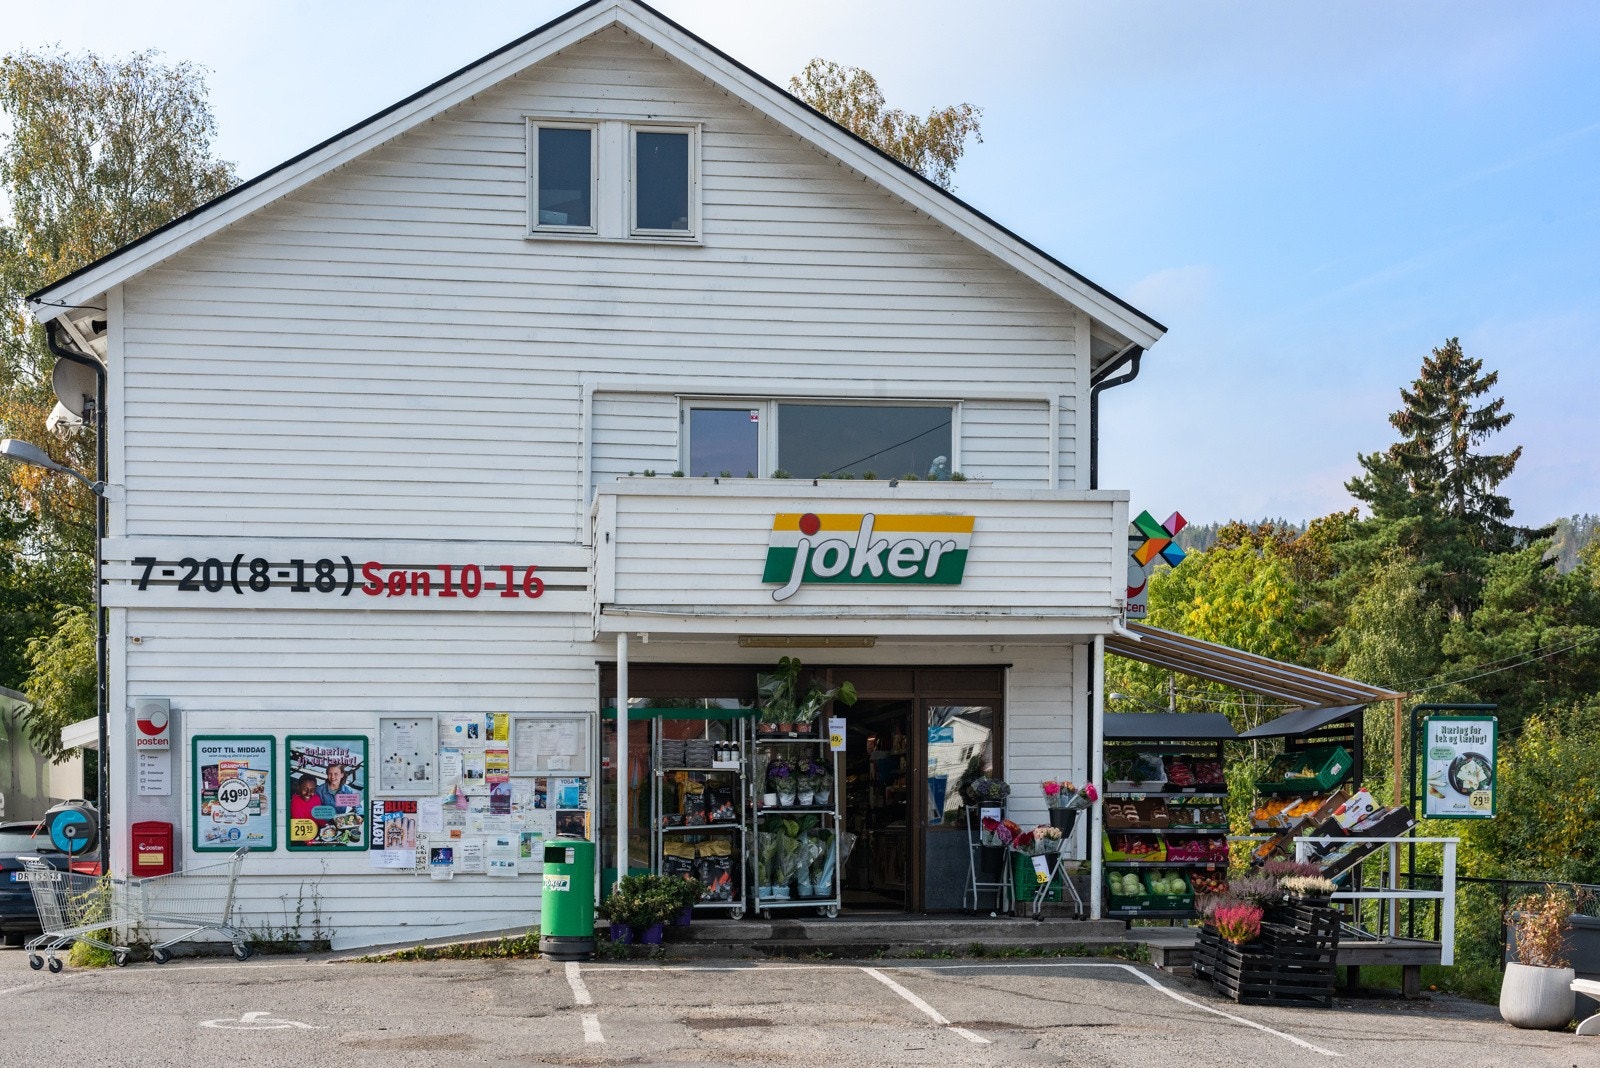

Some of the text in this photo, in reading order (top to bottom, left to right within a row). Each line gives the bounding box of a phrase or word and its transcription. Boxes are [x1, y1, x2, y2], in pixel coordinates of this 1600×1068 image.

[772, 512, 956, 601] joker
[1441, 726, 1482, 736] Næring for
[137, 737, 169, 746] posten
[1435, 734, 1487, 745] lek og læring!
[321, 747, 350, 758] næring
[385, 801, 416, 813] BLUES
[372, 800, 384, 845] RØYKEN
